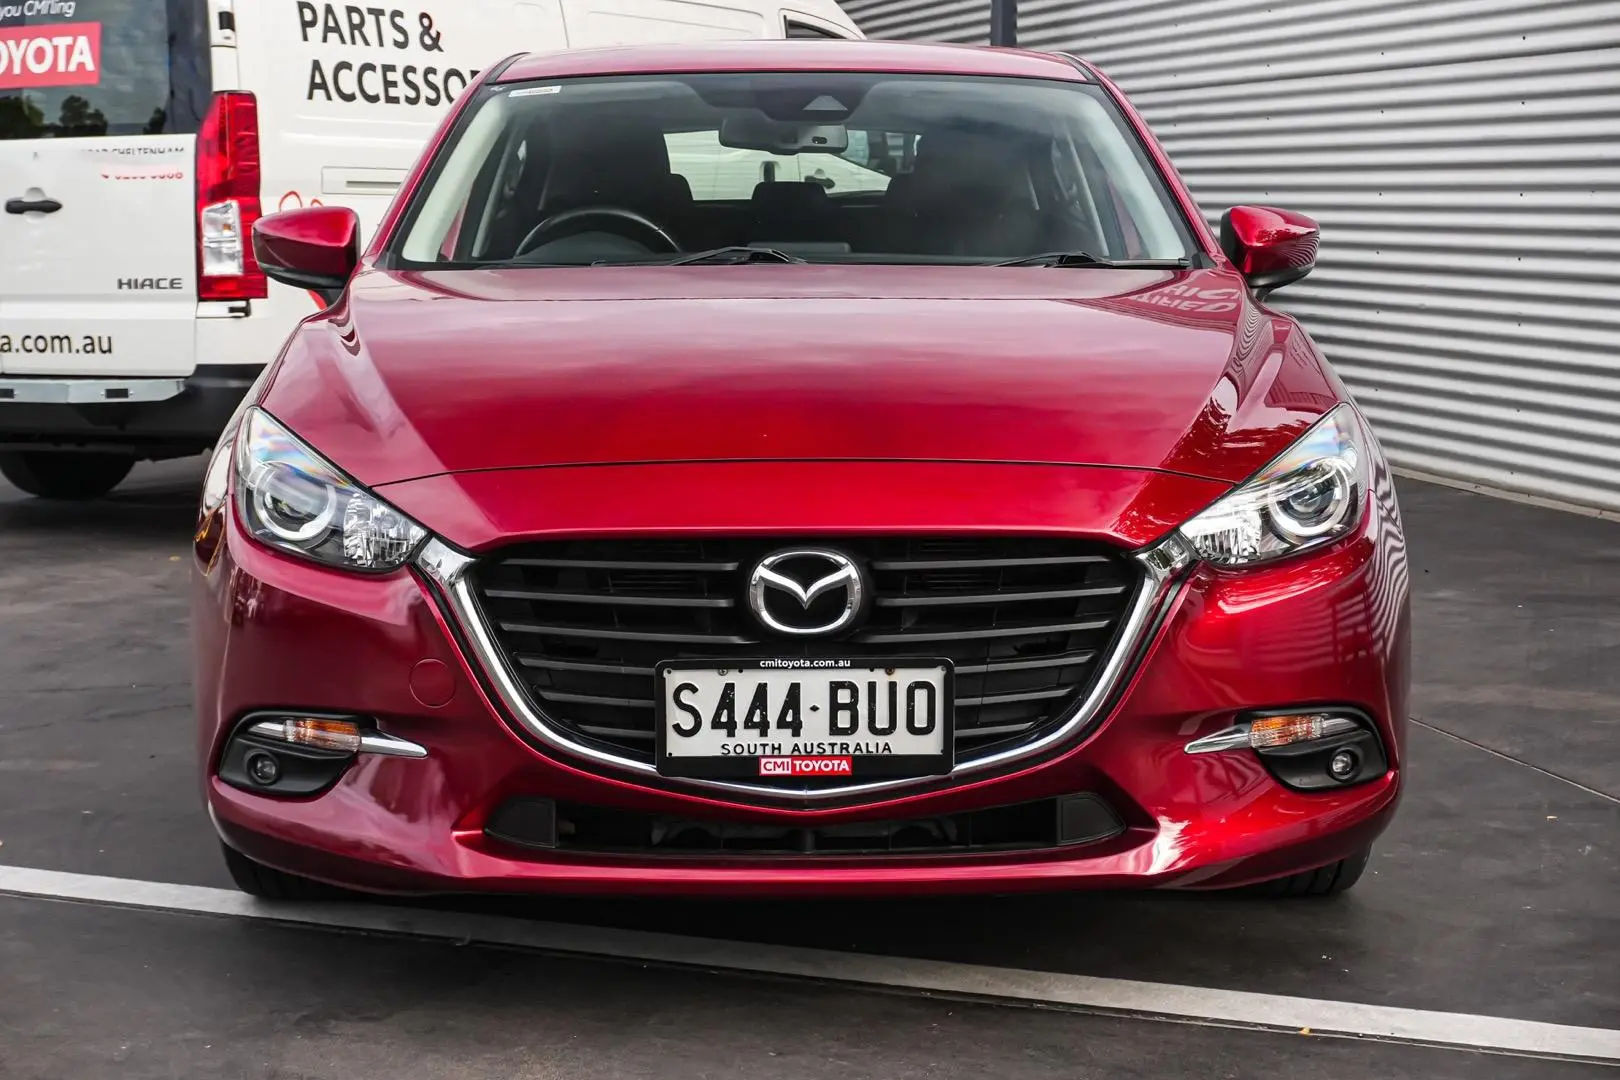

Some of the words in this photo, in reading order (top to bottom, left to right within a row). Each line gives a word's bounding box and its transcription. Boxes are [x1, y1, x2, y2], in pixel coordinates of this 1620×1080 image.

[296, 1, 409, 49] PARTS
[418, 12, 444, 52] &
[307, 59, 482, 106] ACCESSO
[117, 278, 183, 289] HIACE
[0, 335, 113, 353] a.com.au
[759, 658, 851, 669] cmitoyota.com.au
[720, 743, 782, 755] SOUTH
[791, 742, 892, 754] AUSTRALIA
[763, 760, 790, 772] CMI
[793, 759, 850, 772] TOYOTA
